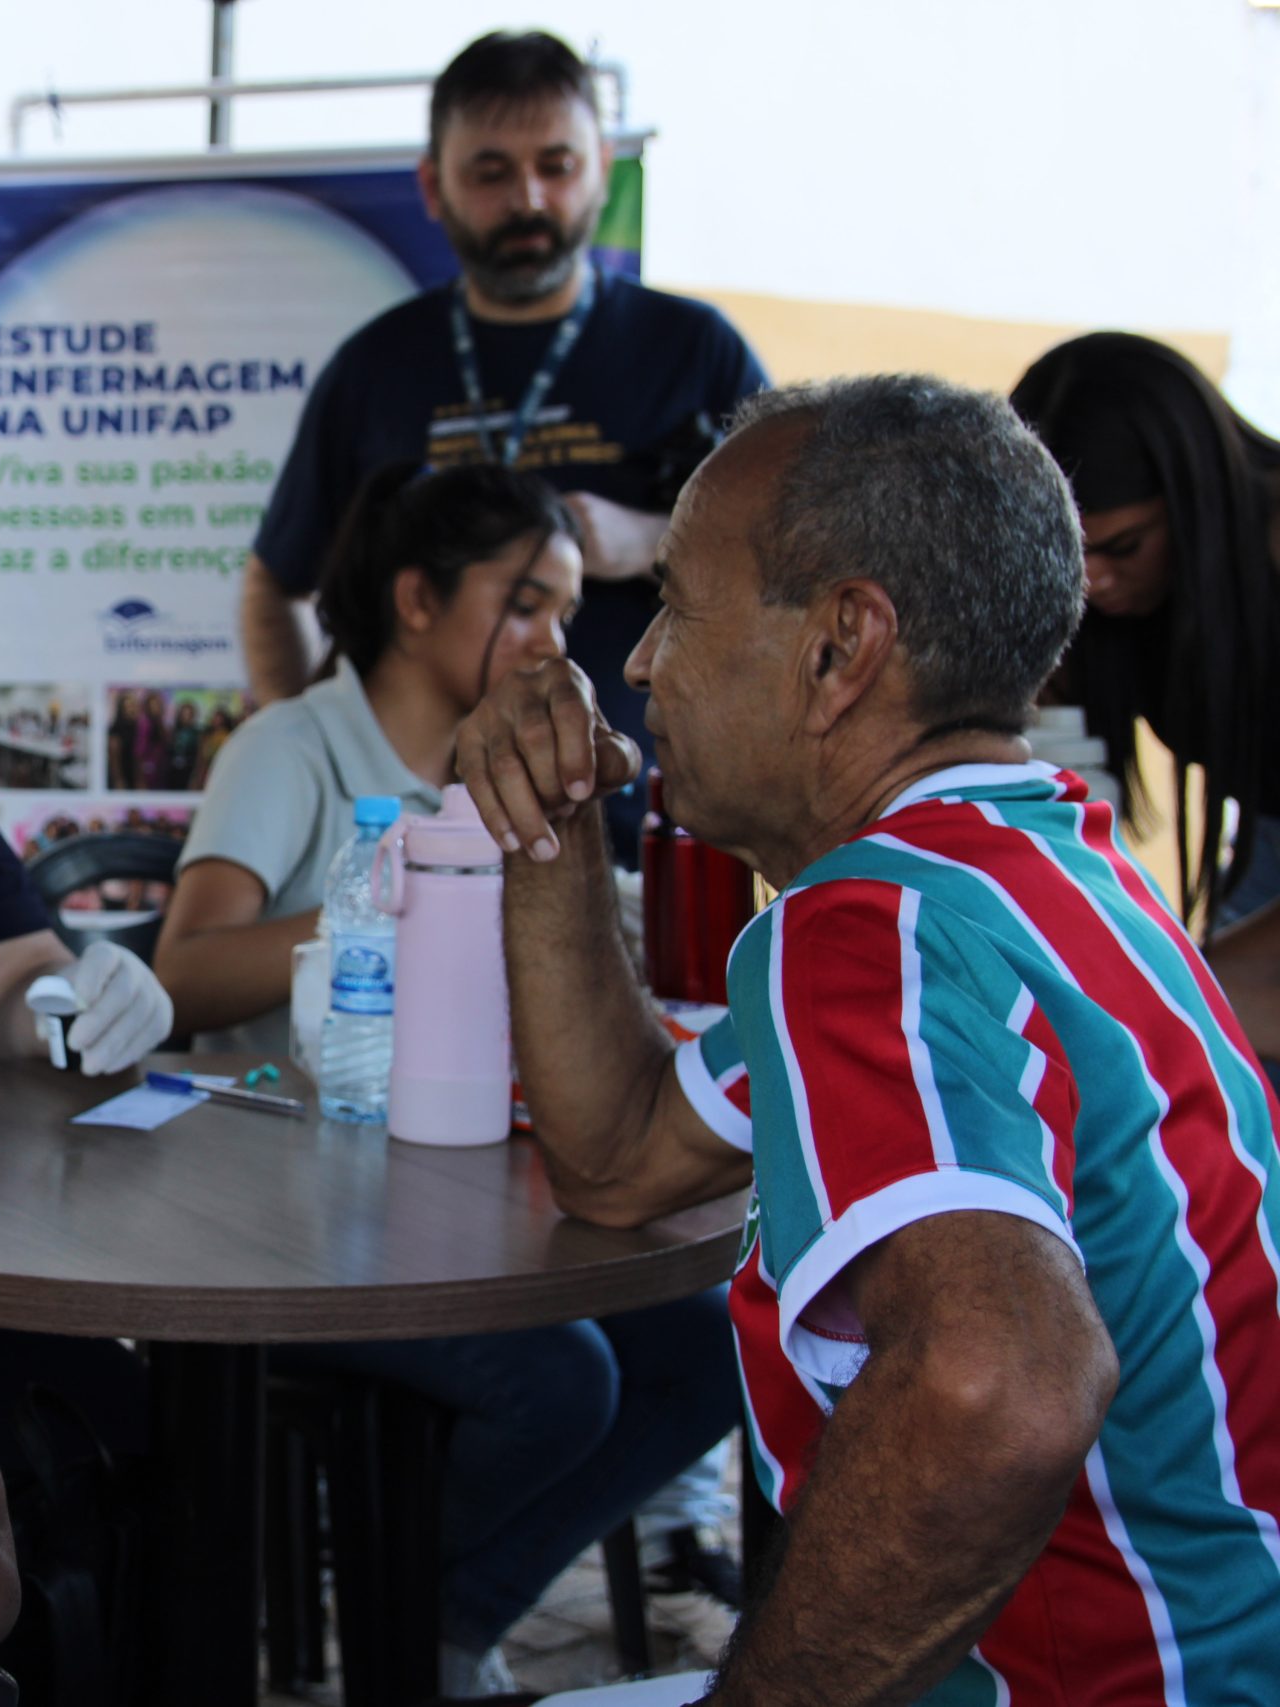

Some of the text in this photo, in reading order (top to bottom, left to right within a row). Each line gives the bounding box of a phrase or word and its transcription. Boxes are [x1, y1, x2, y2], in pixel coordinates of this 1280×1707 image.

[62, 404, 233, 436] UNIFAP
[76, 461, 139, 483] sua
[150, 450, 275, 490] paixão
[138, 504, 195, 527] em
[49, 550, 70, 571] a
